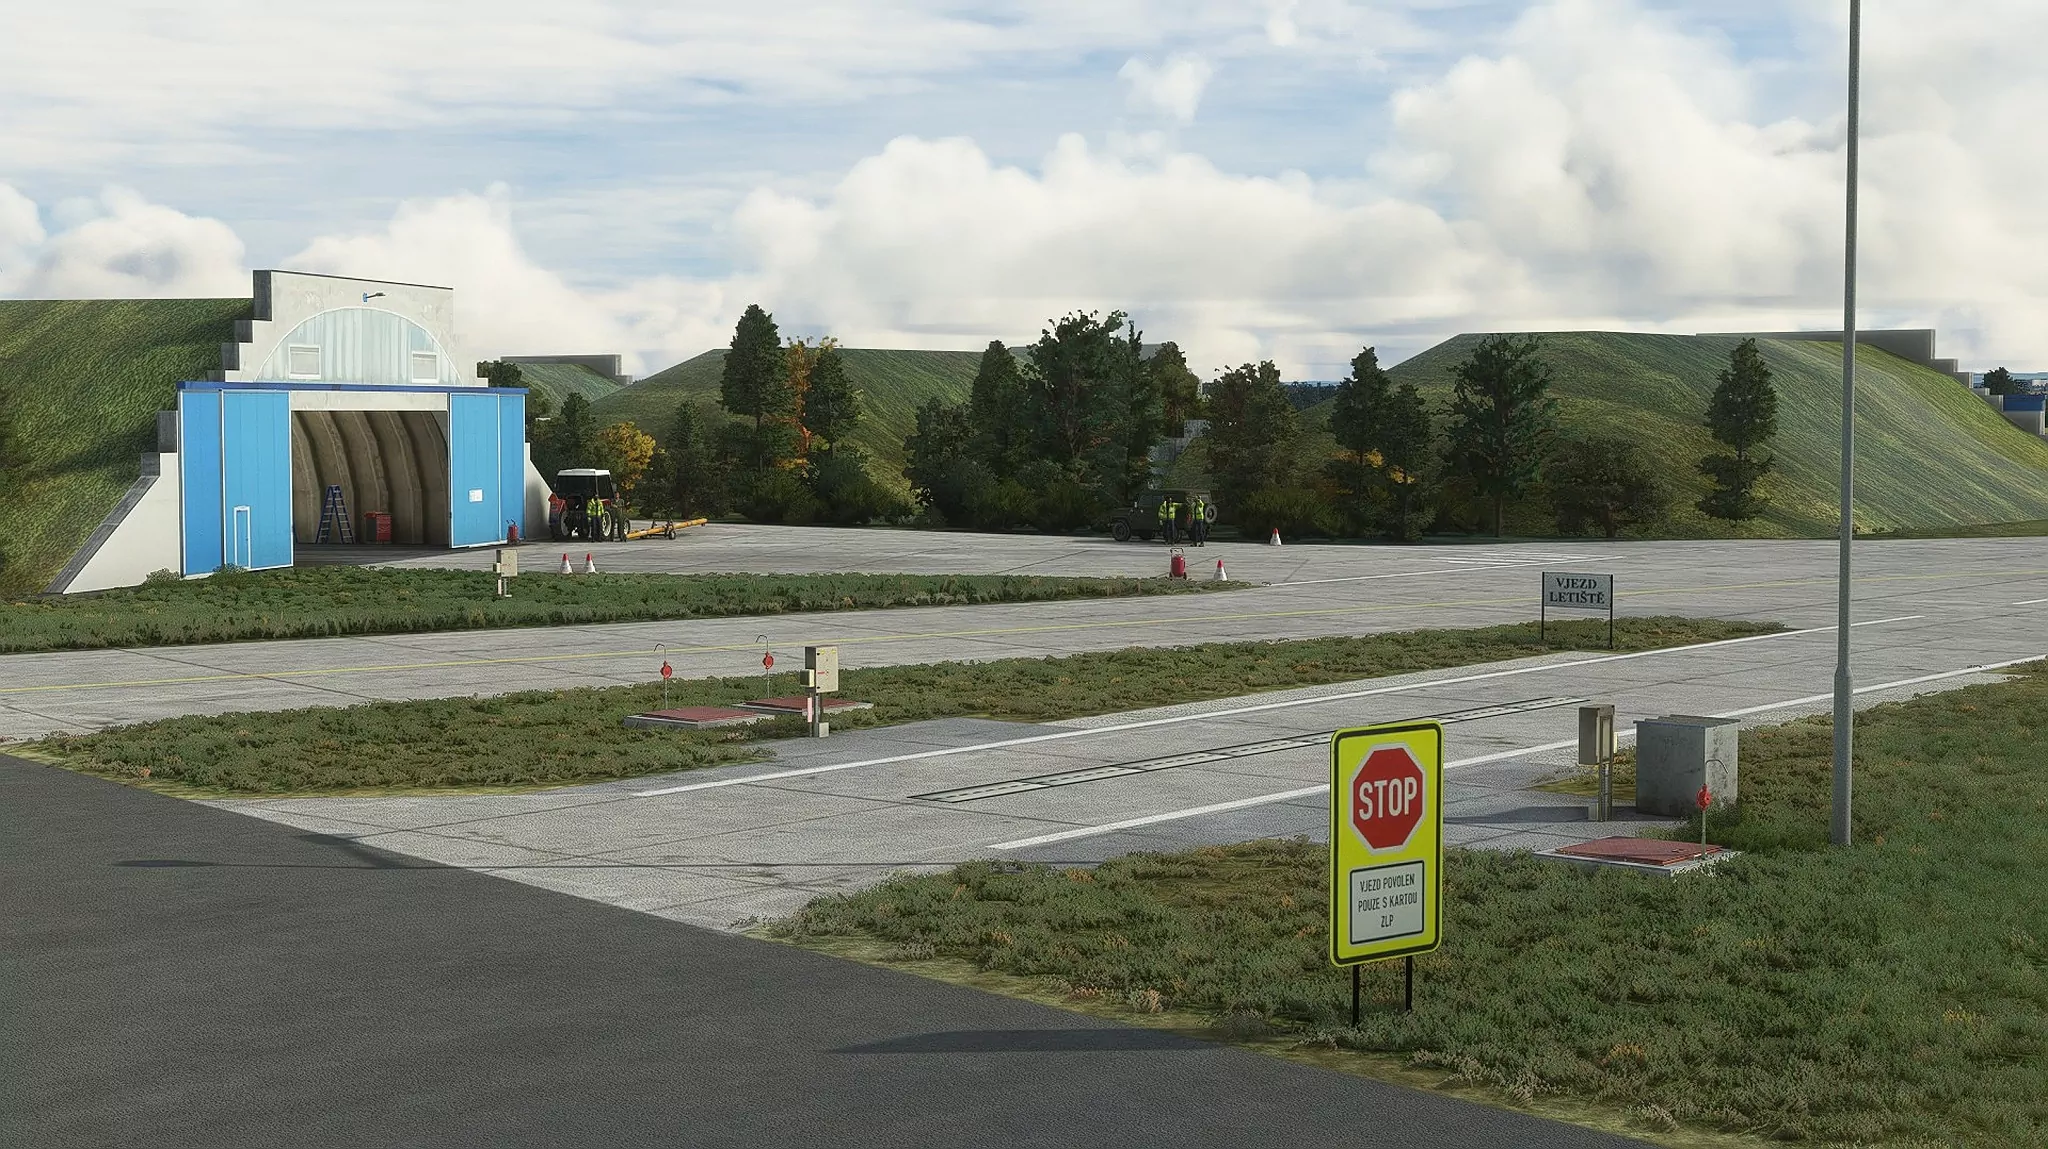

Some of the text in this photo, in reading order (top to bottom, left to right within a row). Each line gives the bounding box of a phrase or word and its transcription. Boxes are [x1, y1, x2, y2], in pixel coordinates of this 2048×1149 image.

[1556, 577, 1597, 589] VJEZD
[1549, 590, 1605, 604] LETIŠTĚ
[1359, 776, 1418, 820] STOP
[1360, 873, 1415, 893] VJEZD POVOLEN
[1358, 892, 1418, 912] POUZE S KARTOU
[1381, 914, 1394, 928] ZLP
